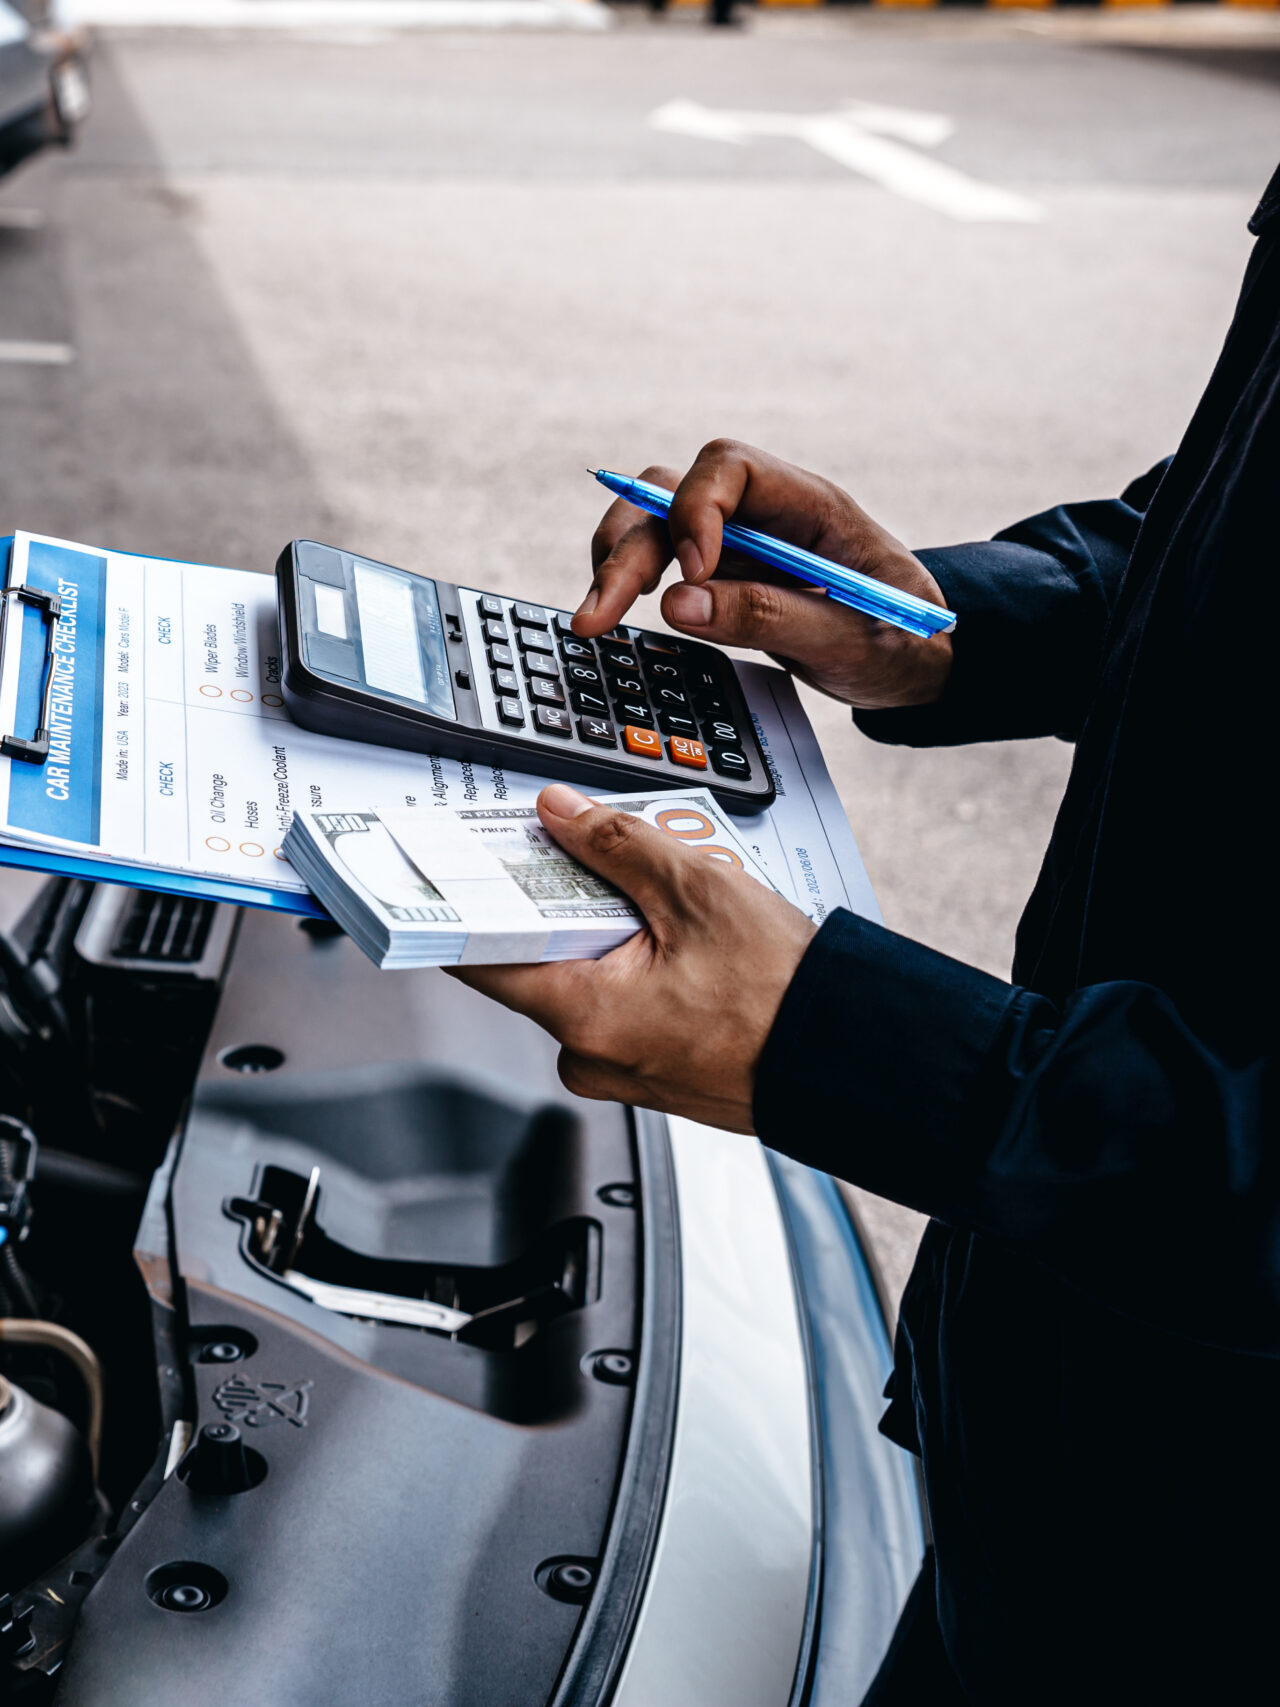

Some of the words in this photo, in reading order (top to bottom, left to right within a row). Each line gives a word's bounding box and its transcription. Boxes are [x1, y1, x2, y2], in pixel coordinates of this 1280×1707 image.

[487, 599, 498, 610] GT
[54, 577, 79, 653] CHECKLIST
[158, 616, 171, 645] CHECK
[204, 624, 217, 649] Blades
[231, 602, 250, 678] Window/Windshield
[568, 643, 592, 654] 9
[118, 651, 129, 673] Model:
[204, 651, 221, 673] Wiper
[610, 654, 634, 666] 6
[264, 656, 280, 684] Cracks
[574, 668, 598, 680] 8
[654, 664, 677, 676] 3
[119, 682, 129, 699] 2023
[541, 681, 556, 697] MR
[617, 678, 641, 691] 5
[580, 693, 604, 706] 7
[661, 689, 685, 701] 2
[49, 653, 75, 761] MAINTENANCE
[117, 701, 129, 718] Year:
[507, 702, 519, 715] MU
[624, 704, 648, 717] 4
[546, 710, 563, 727] MC
[669, 716, 692, 724] 1
[118, 730, 129, 747] USA
[633, 732, 654, 745] C
[713, 722, 737, 740] 00
[674, 739, 690, 756] AC
[721, 752, 746, 764] 0
[116, 758, 129, 780] Made
[46, 762, 70, 801] CAR
[159, 762, 174, 797] CHECK
[211, 773, 228, 807] Change
[210, 807, 226, 824] Oil
[244, 800, 259, 829] Hoses
[796, 847, 821, 894] 2023/06/08
